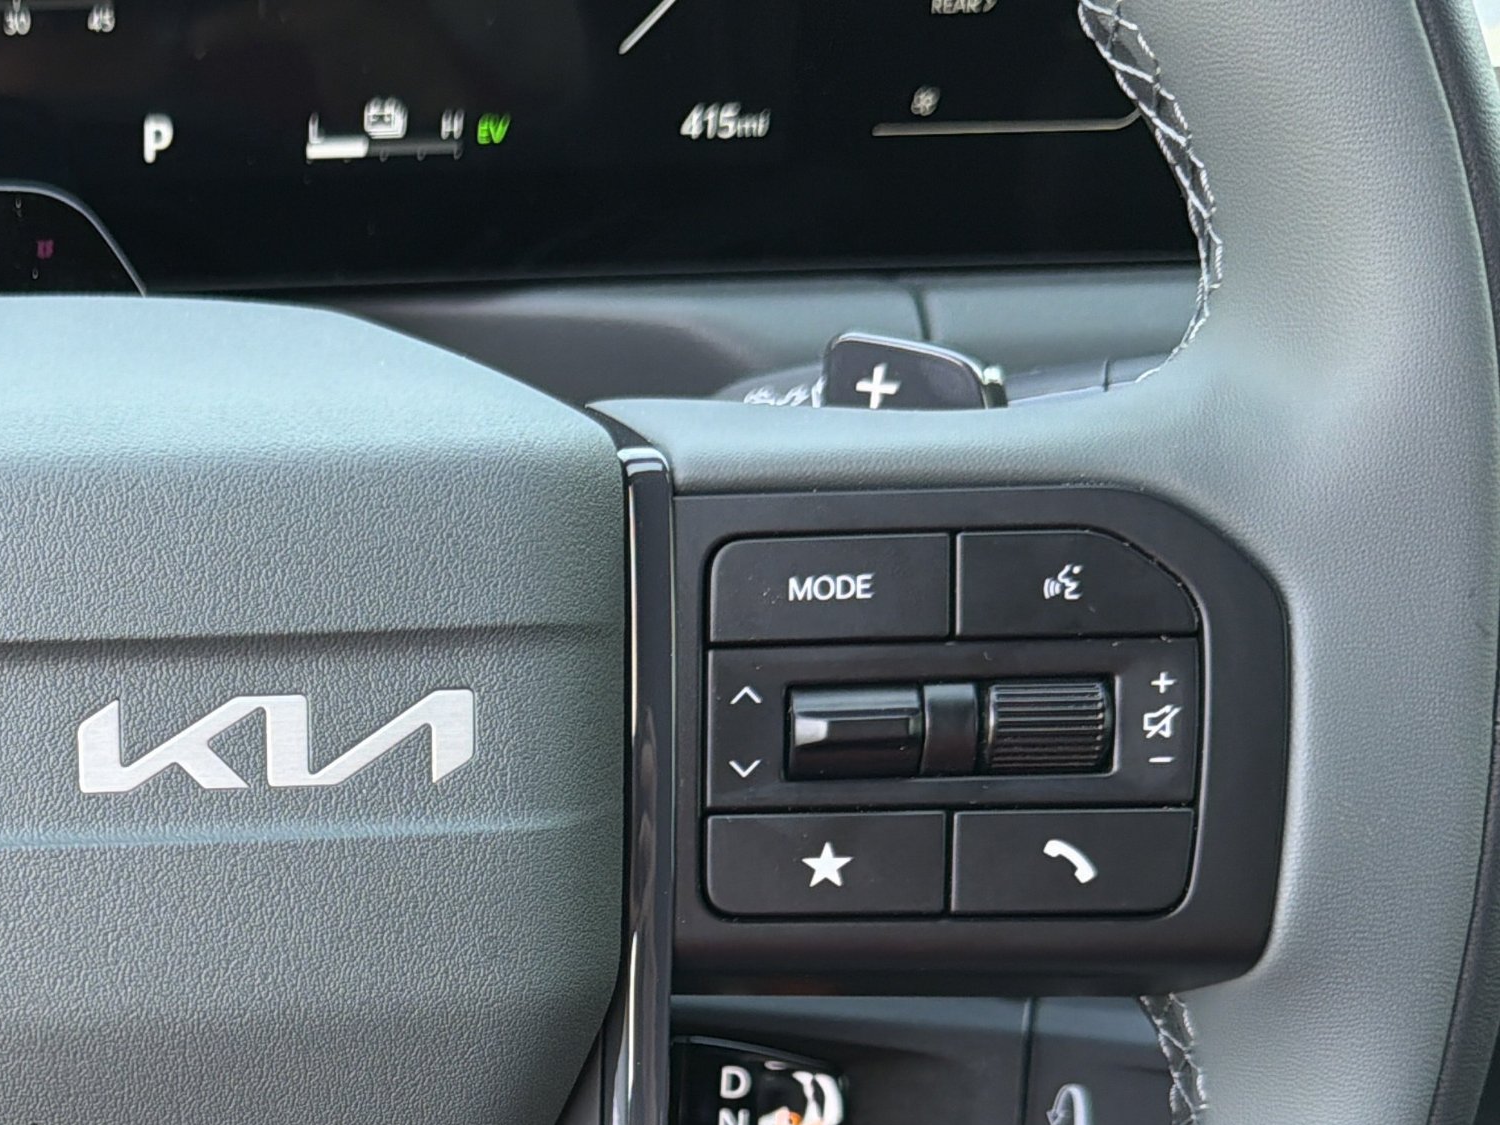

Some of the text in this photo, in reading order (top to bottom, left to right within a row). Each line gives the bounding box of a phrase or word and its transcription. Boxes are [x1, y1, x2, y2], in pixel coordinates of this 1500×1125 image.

[143, 112, 174, 164] P
[477, 112, 511, 145] EV
[787, 573, 875, 602] MODE
[720, 1065, 752, 1099] D
